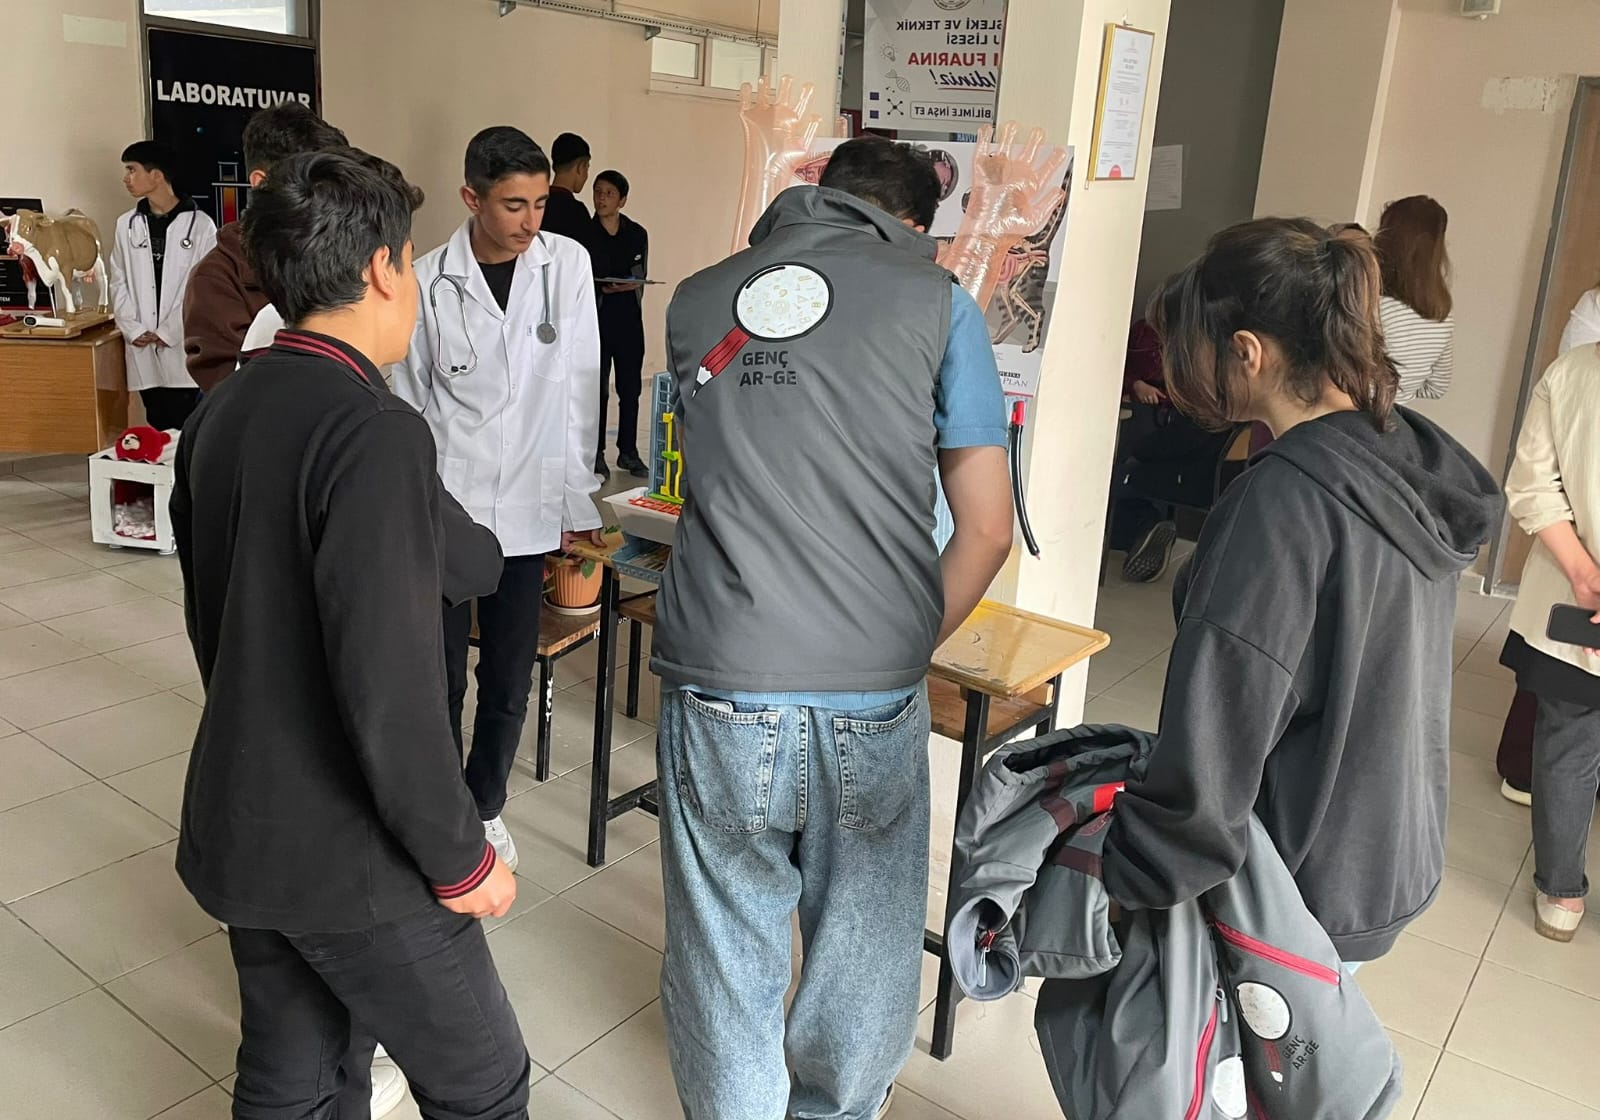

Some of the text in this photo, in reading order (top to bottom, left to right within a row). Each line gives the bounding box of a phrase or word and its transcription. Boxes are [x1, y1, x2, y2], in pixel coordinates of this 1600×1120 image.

[742, 351, 788, 368] GENÇ
[739, 371, 797, 387] AR-GE
[1282, 1035, 1305, 1059] GENÇ
[1292, 1040, 1319, 1070] AR-GE
